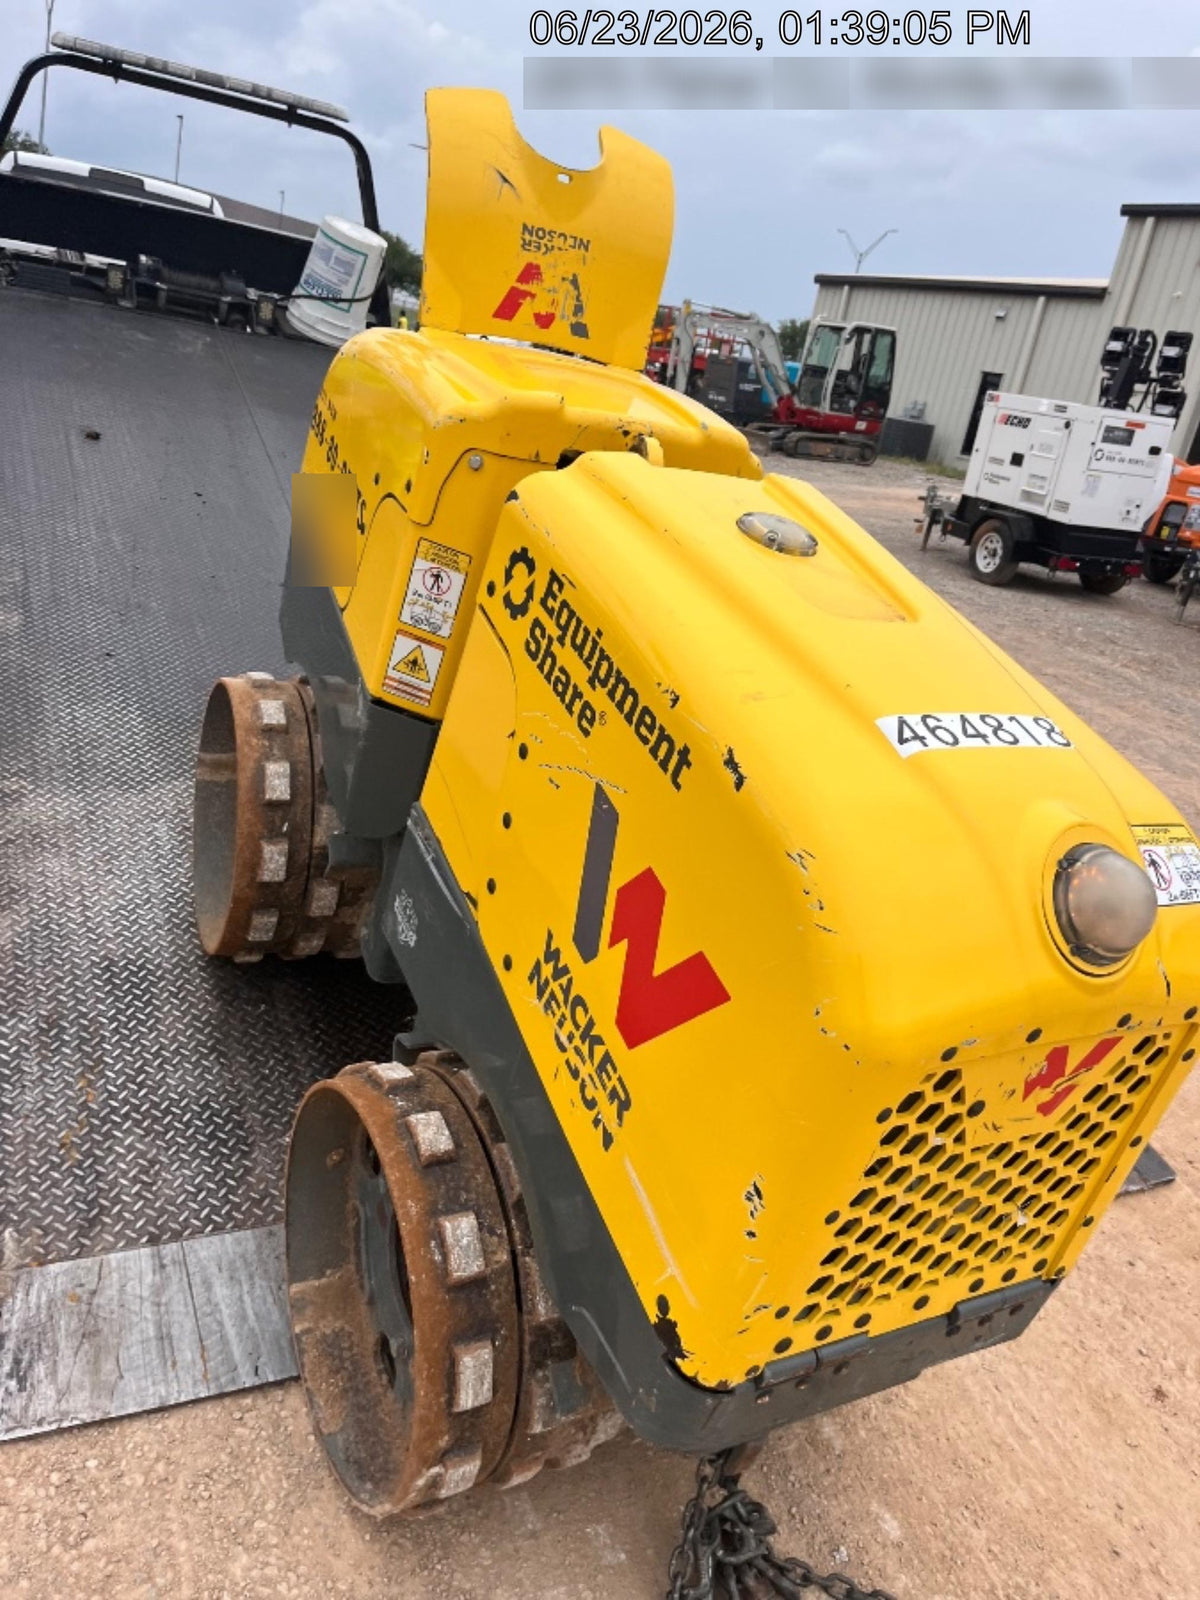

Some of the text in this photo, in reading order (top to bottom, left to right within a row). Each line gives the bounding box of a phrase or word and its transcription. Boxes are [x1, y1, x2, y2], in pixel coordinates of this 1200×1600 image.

[540, 568, 693, 793] Equipment
[896, 713, 1072, 748] 464818
[543, 927, 632, 1128] WACKER
